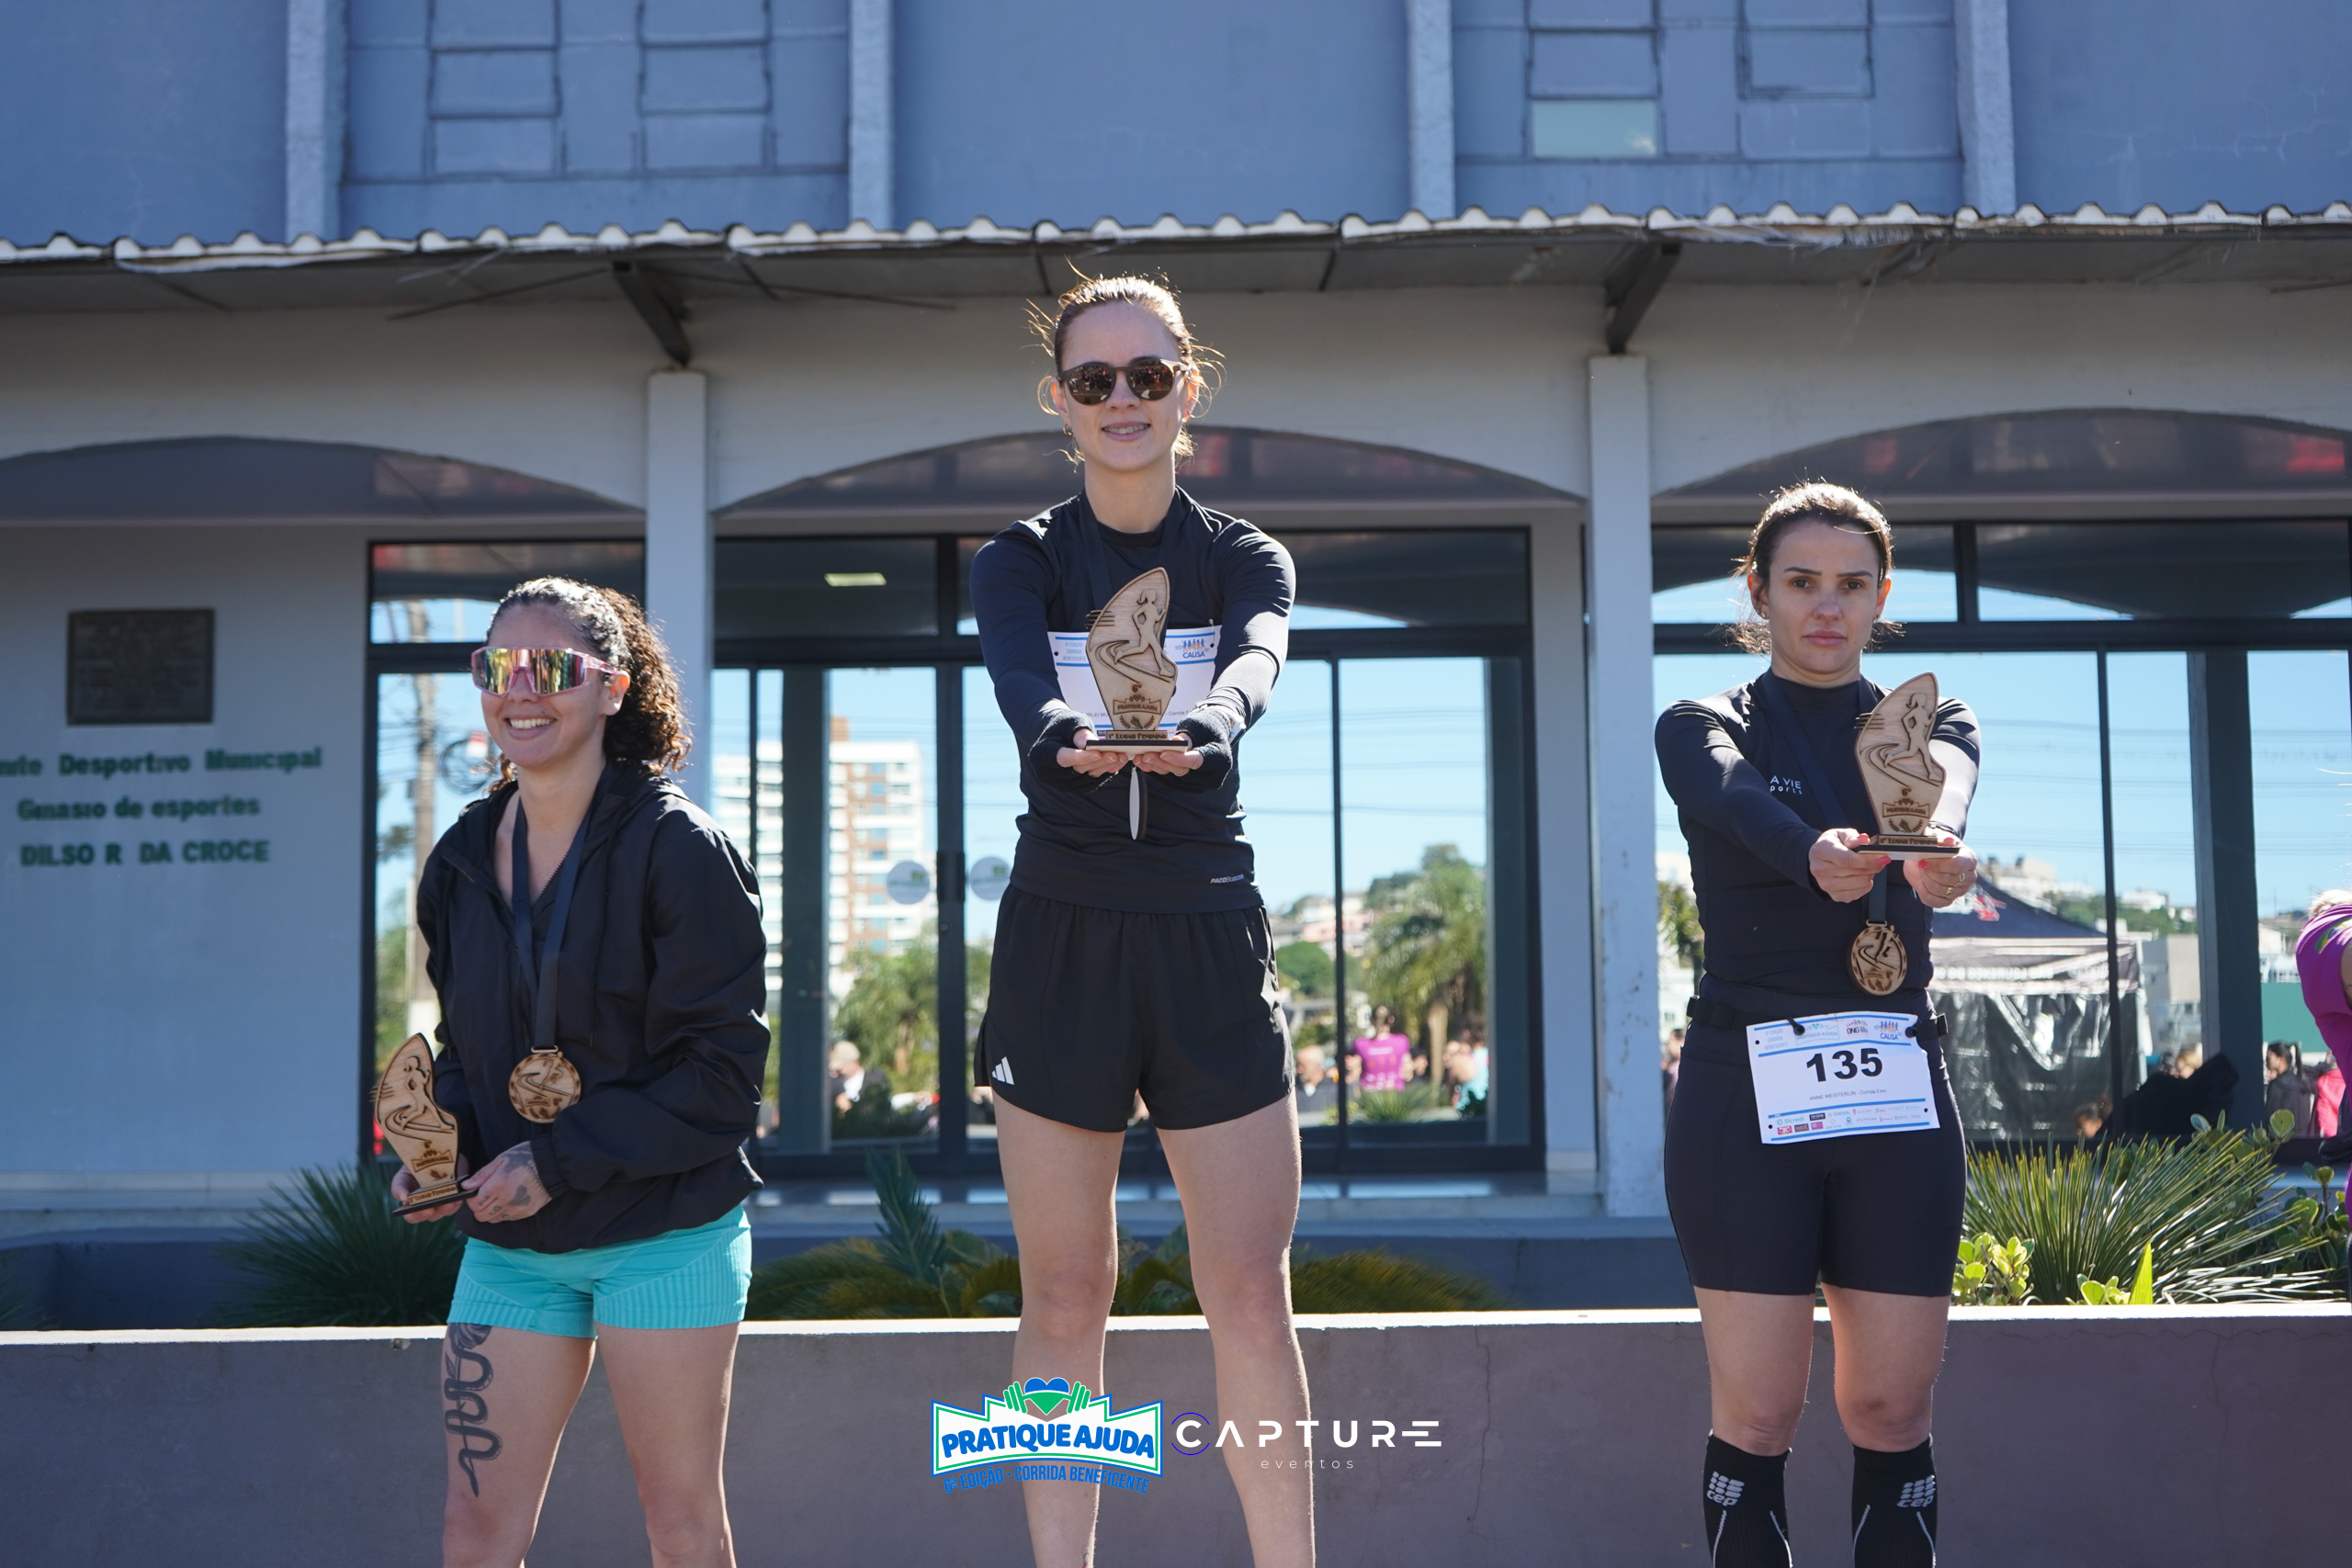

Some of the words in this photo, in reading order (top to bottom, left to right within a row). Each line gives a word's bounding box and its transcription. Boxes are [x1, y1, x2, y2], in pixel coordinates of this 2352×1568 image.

[59, 752, 191, 779] Desportivo
[205, 745, 322, 774] Municipal
[1770, 775, 1780, 785] A
[1782, 777, 1802, 789] VIE
[1770, 785, 1803, 795] ports
[115, 795, 142, 818] de
[152, 795, 261, 822] esportes
[20, 841, 95, 867] DILSO
[105, 842, 122, 865] R
[140, 841, 173, 865] DA
[182, 840, 269, 863] CROCE
[1880, 1032, 1899, 1041] CAUSA
[1806, 1048, 1883, 1082] 135
[1706, 1489, 1737, 1507] cep
